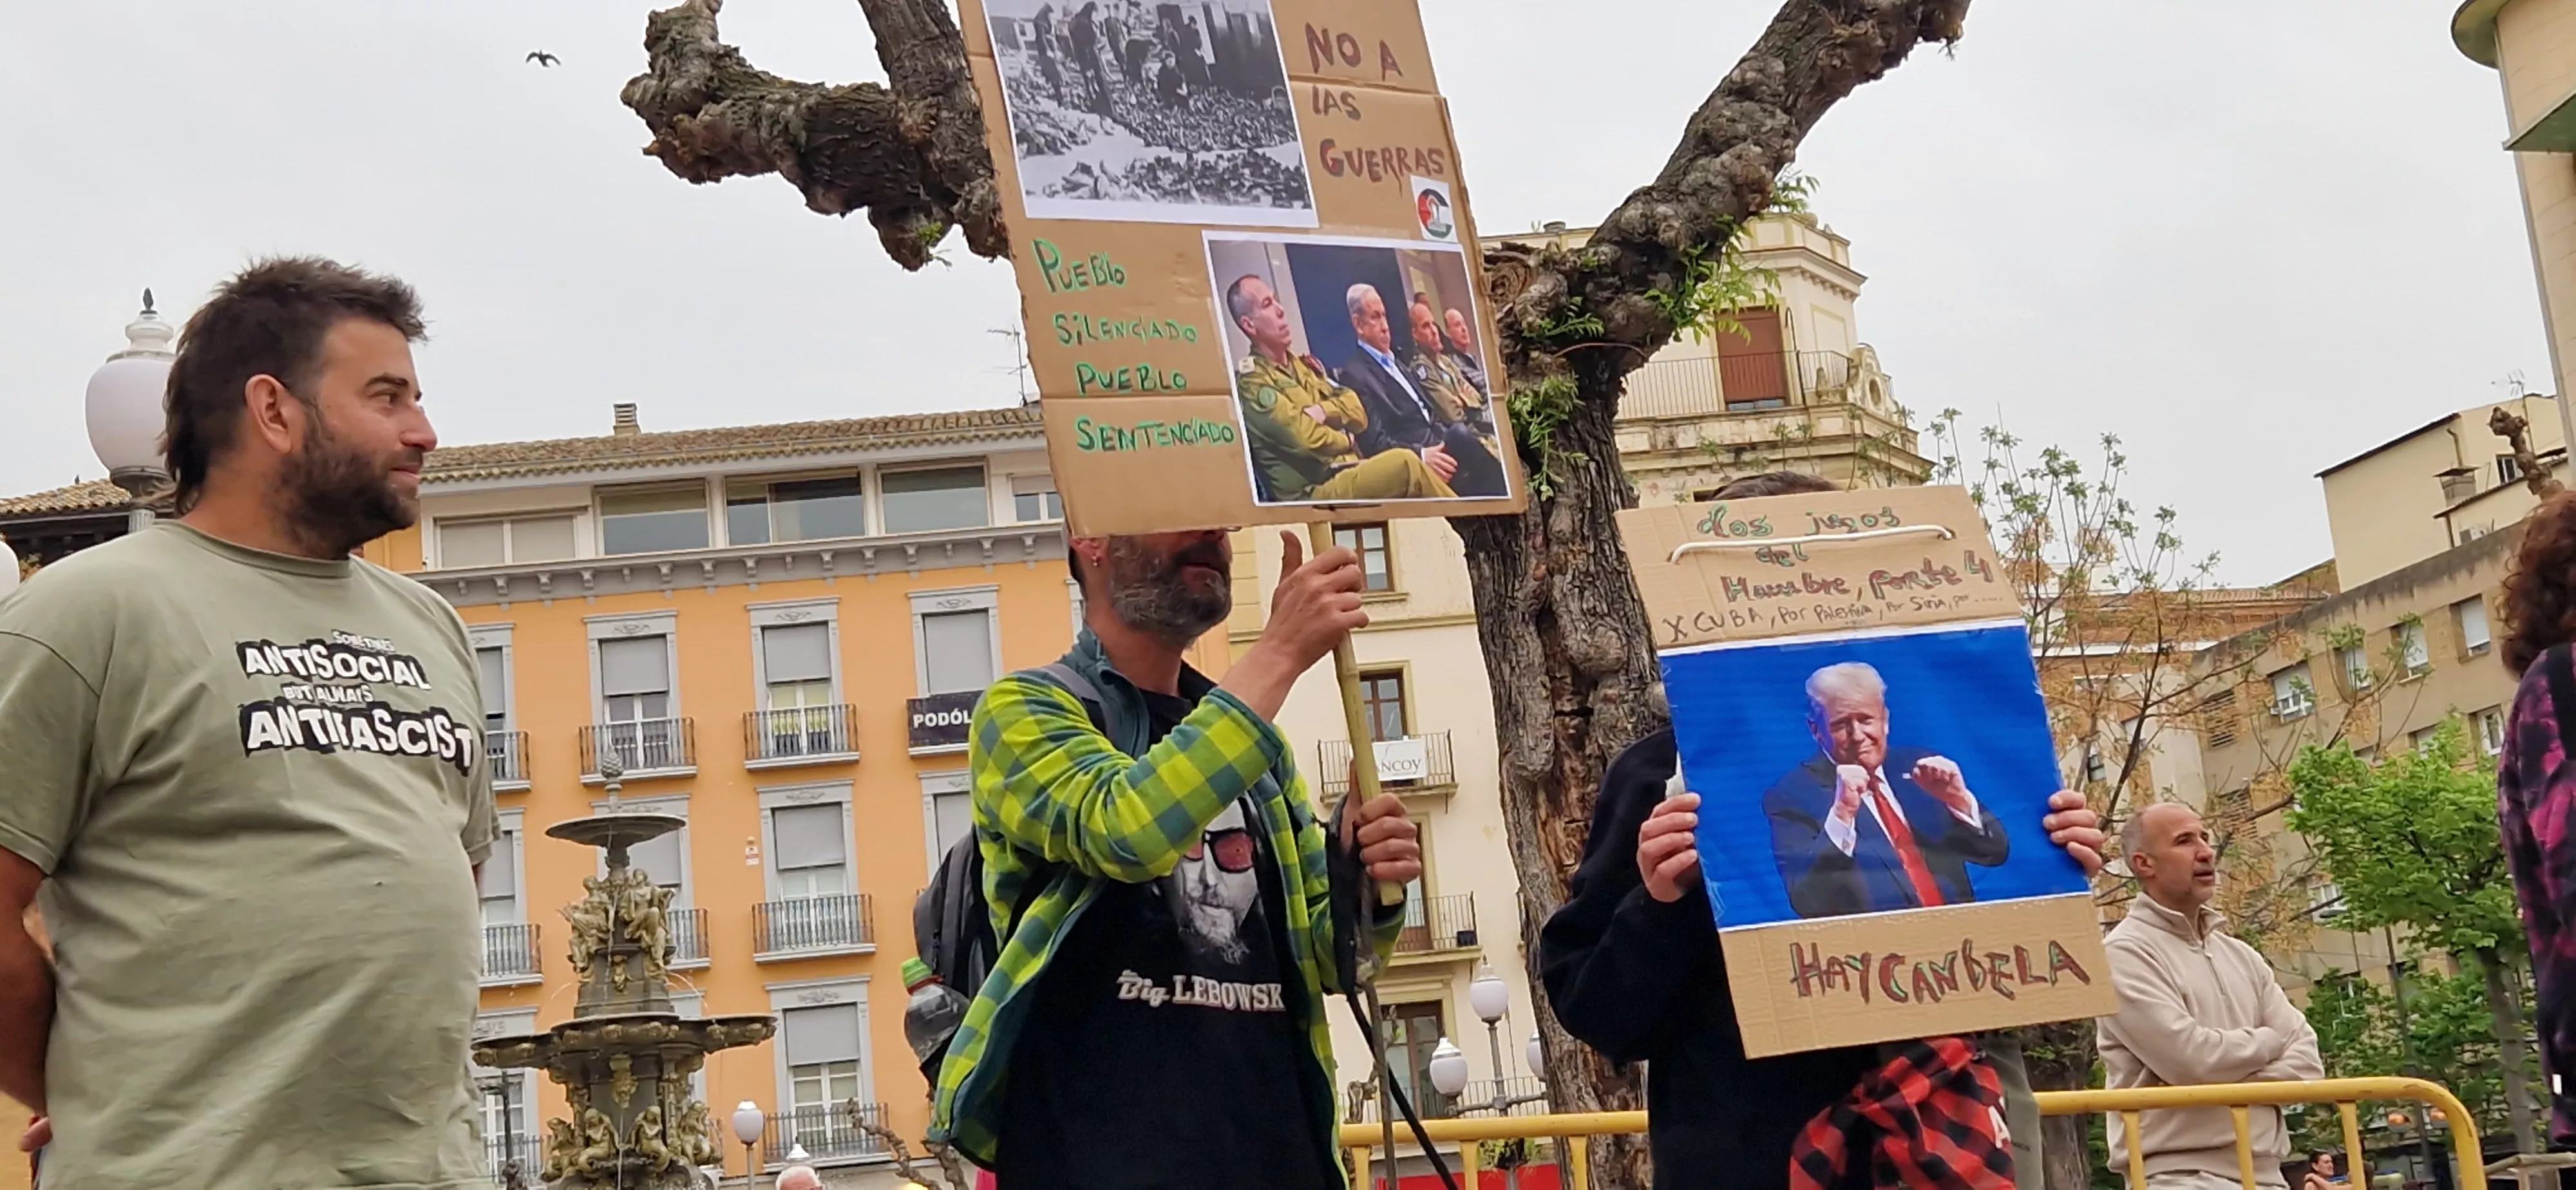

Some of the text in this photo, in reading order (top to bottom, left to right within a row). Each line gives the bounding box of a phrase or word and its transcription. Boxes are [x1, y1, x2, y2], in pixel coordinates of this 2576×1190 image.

[1305, 21, 1403, 82] NO A
[1320, 138, 1444, 198] GUERRAS
[1075, 363, 1189, 396] PUEBLO
[1076, 415, 1236, 453] SENTENCIADO
[1964, 549, 1994, 583] 4
[245, 644, 431, 690] ANTISOCIAL
[282, 685, 313, 701] BUT
[1789, 941, 1872, 1005] HAY
